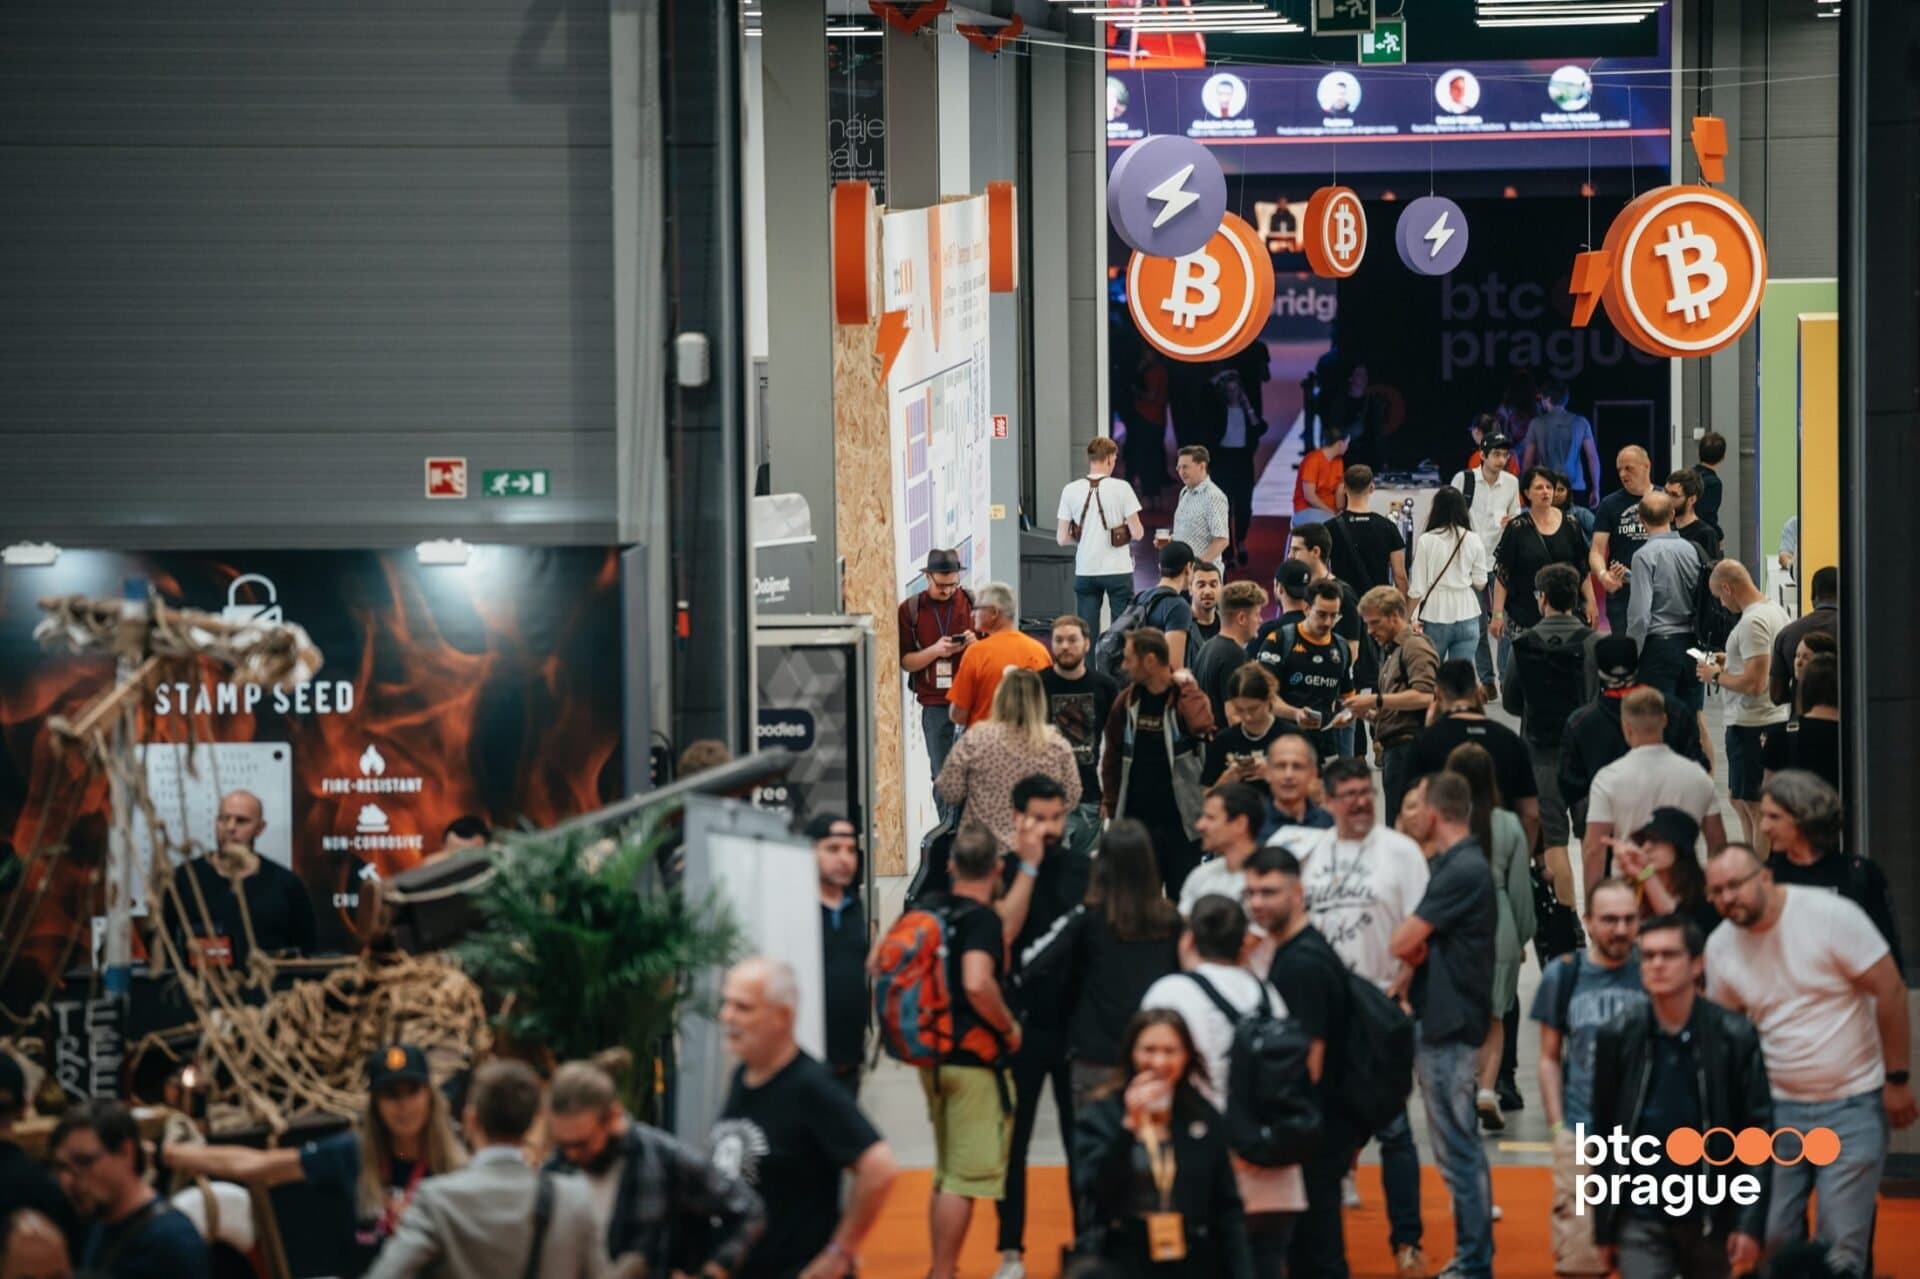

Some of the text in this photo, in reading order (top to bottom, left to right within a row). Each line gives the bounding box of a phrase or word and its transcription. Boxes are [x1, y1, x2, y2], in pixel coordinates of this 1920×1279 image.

[1440, 271, 1546, 320] btc
[154, 681, 354, 715] STAMP SEED
[322, 777, 423, 793] FIRE-RESISTANT
[322, 835, 424, 850] NON-CORROSIVE
